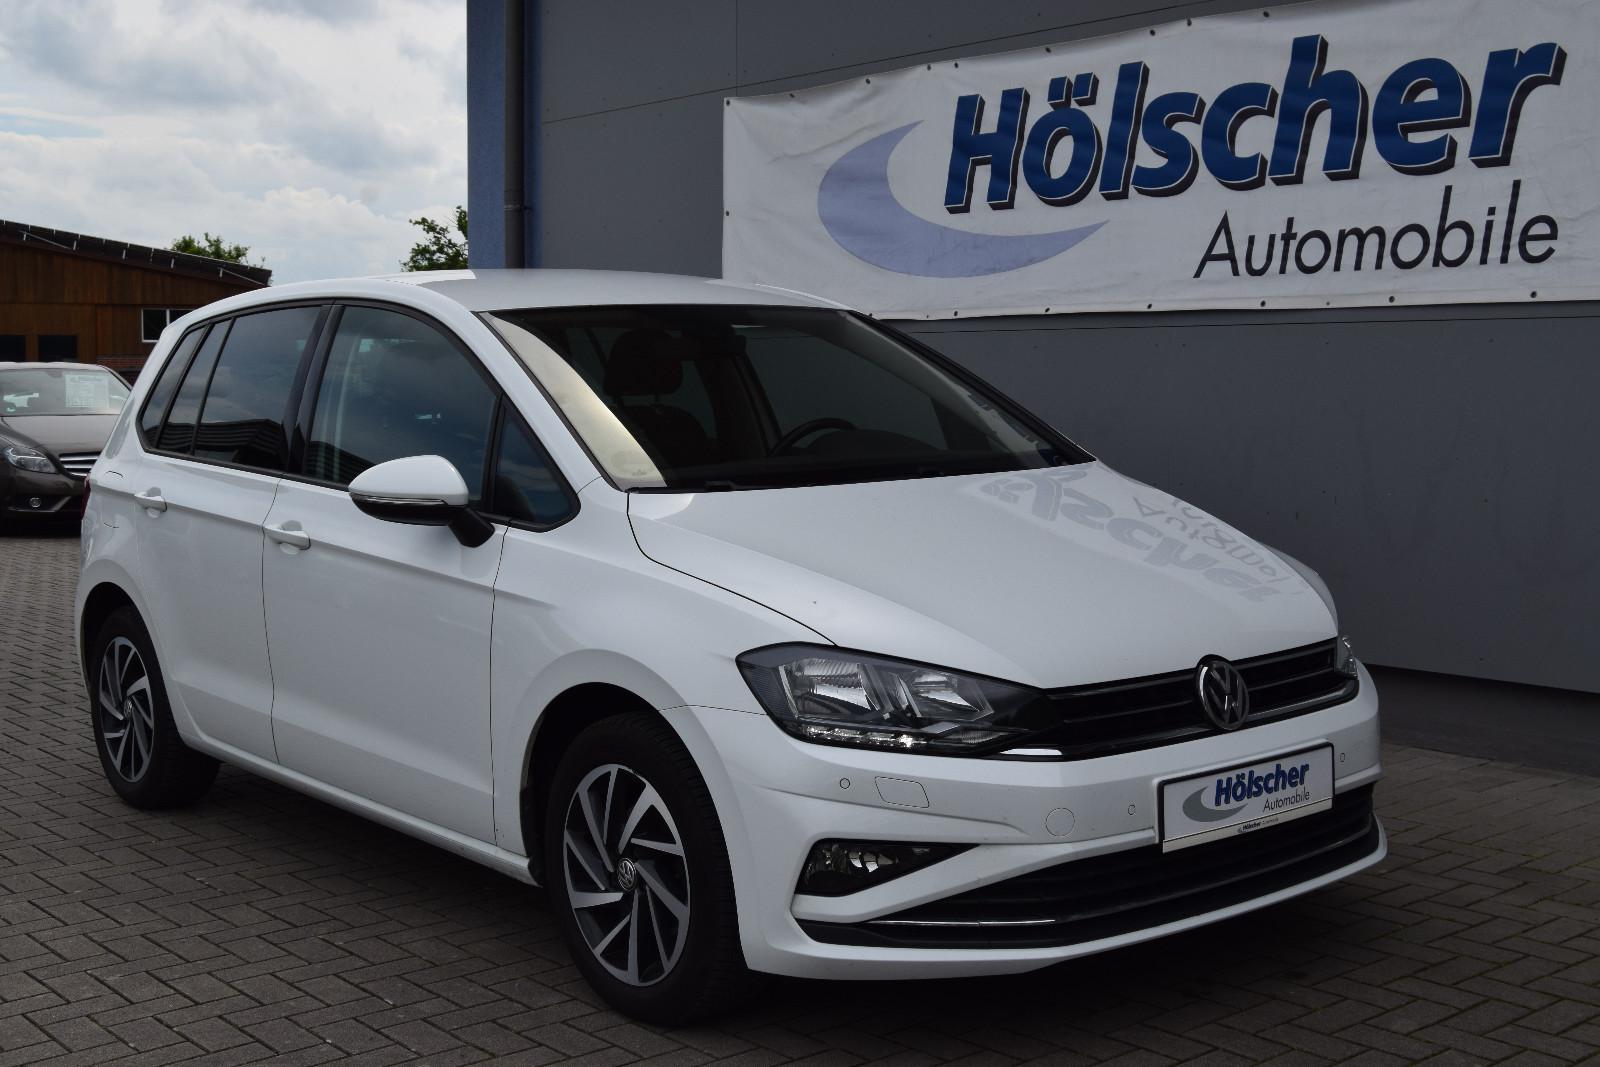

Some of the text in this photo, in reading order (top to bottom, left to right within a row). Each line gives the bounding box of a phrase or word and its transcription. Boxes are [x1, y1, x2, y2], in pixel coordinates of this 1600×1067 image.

[944, 34, 1567, 214] Hölscher
[1193, 179, 1559, 279] Automobile
[1214, 763, 1310, 806] Hölscher
[1263, 786, 1310, 813] Automobile
